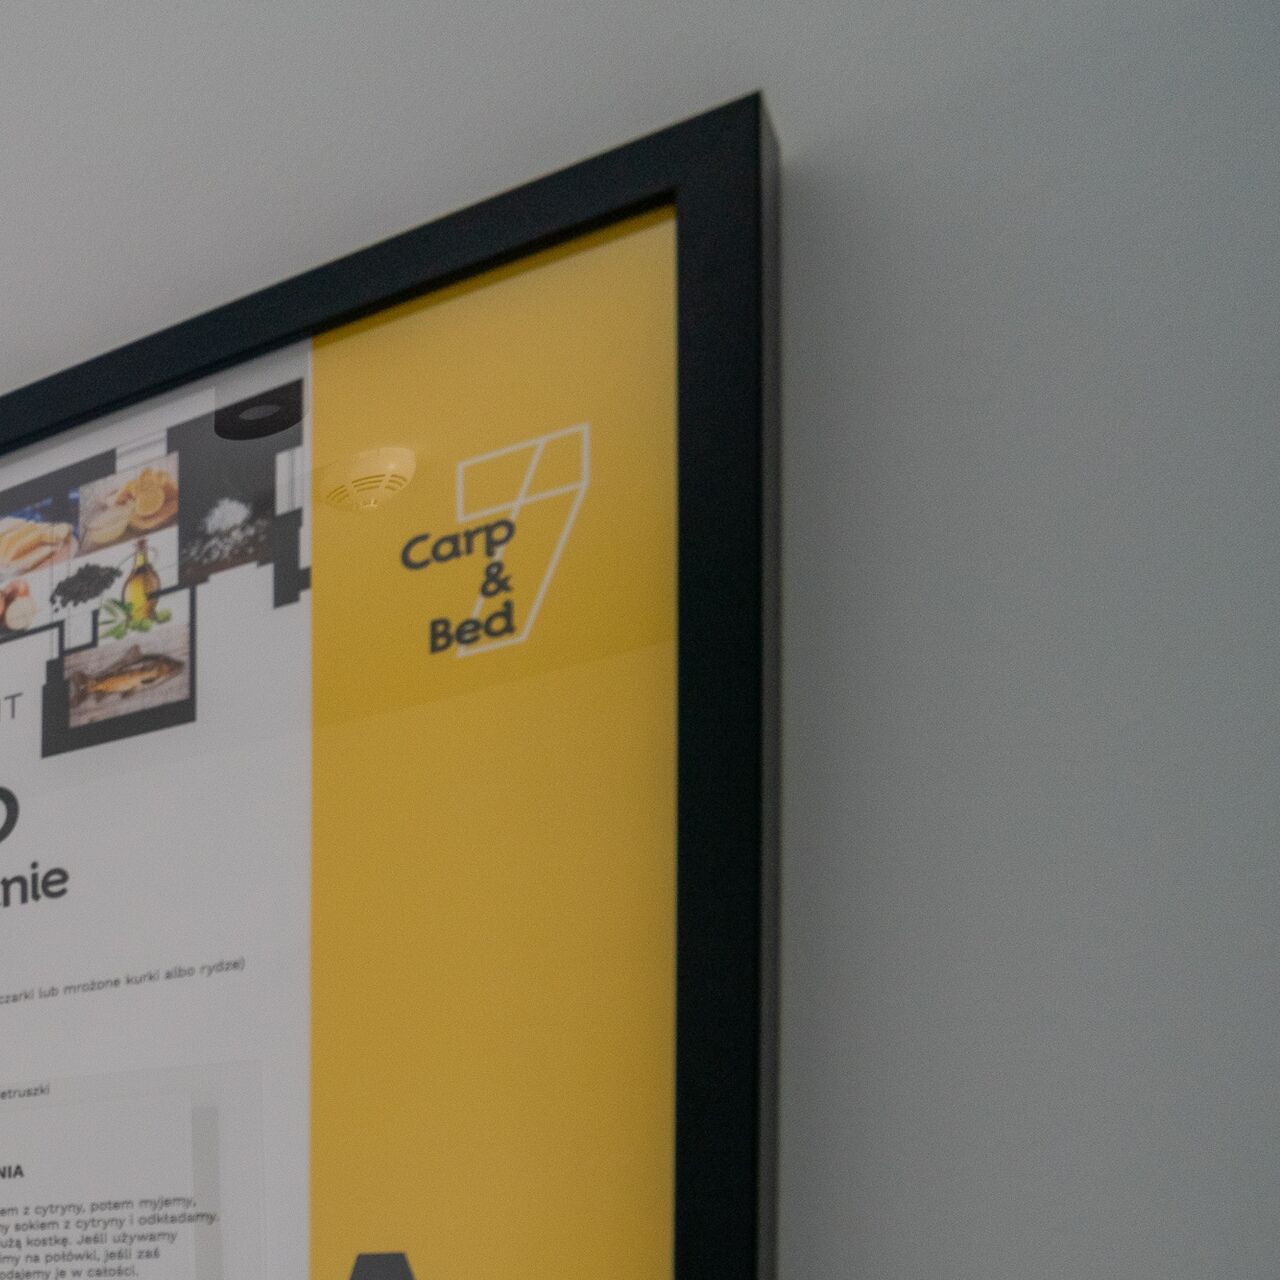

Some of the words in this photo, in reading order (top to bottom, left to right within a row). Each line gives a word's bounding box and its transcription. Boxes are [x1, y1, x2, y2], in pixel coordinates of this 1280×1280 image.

[401, 519, 515, 570] Carp
[481, 561, 513, 598] &
[429, 601, 515, 654] Bed
[37, 985, 59, 999] lub
[62, 976, 121, 996] mrożone
[124, 970, 159, 988] kurki
[163, 965, 196, 981] albo
[22, 1206, 30, 1215] z
[89, 1198, 134, 1214] potem
[53, 1267, 67, 1280] je
[69, 1268, 83, 1277] w
